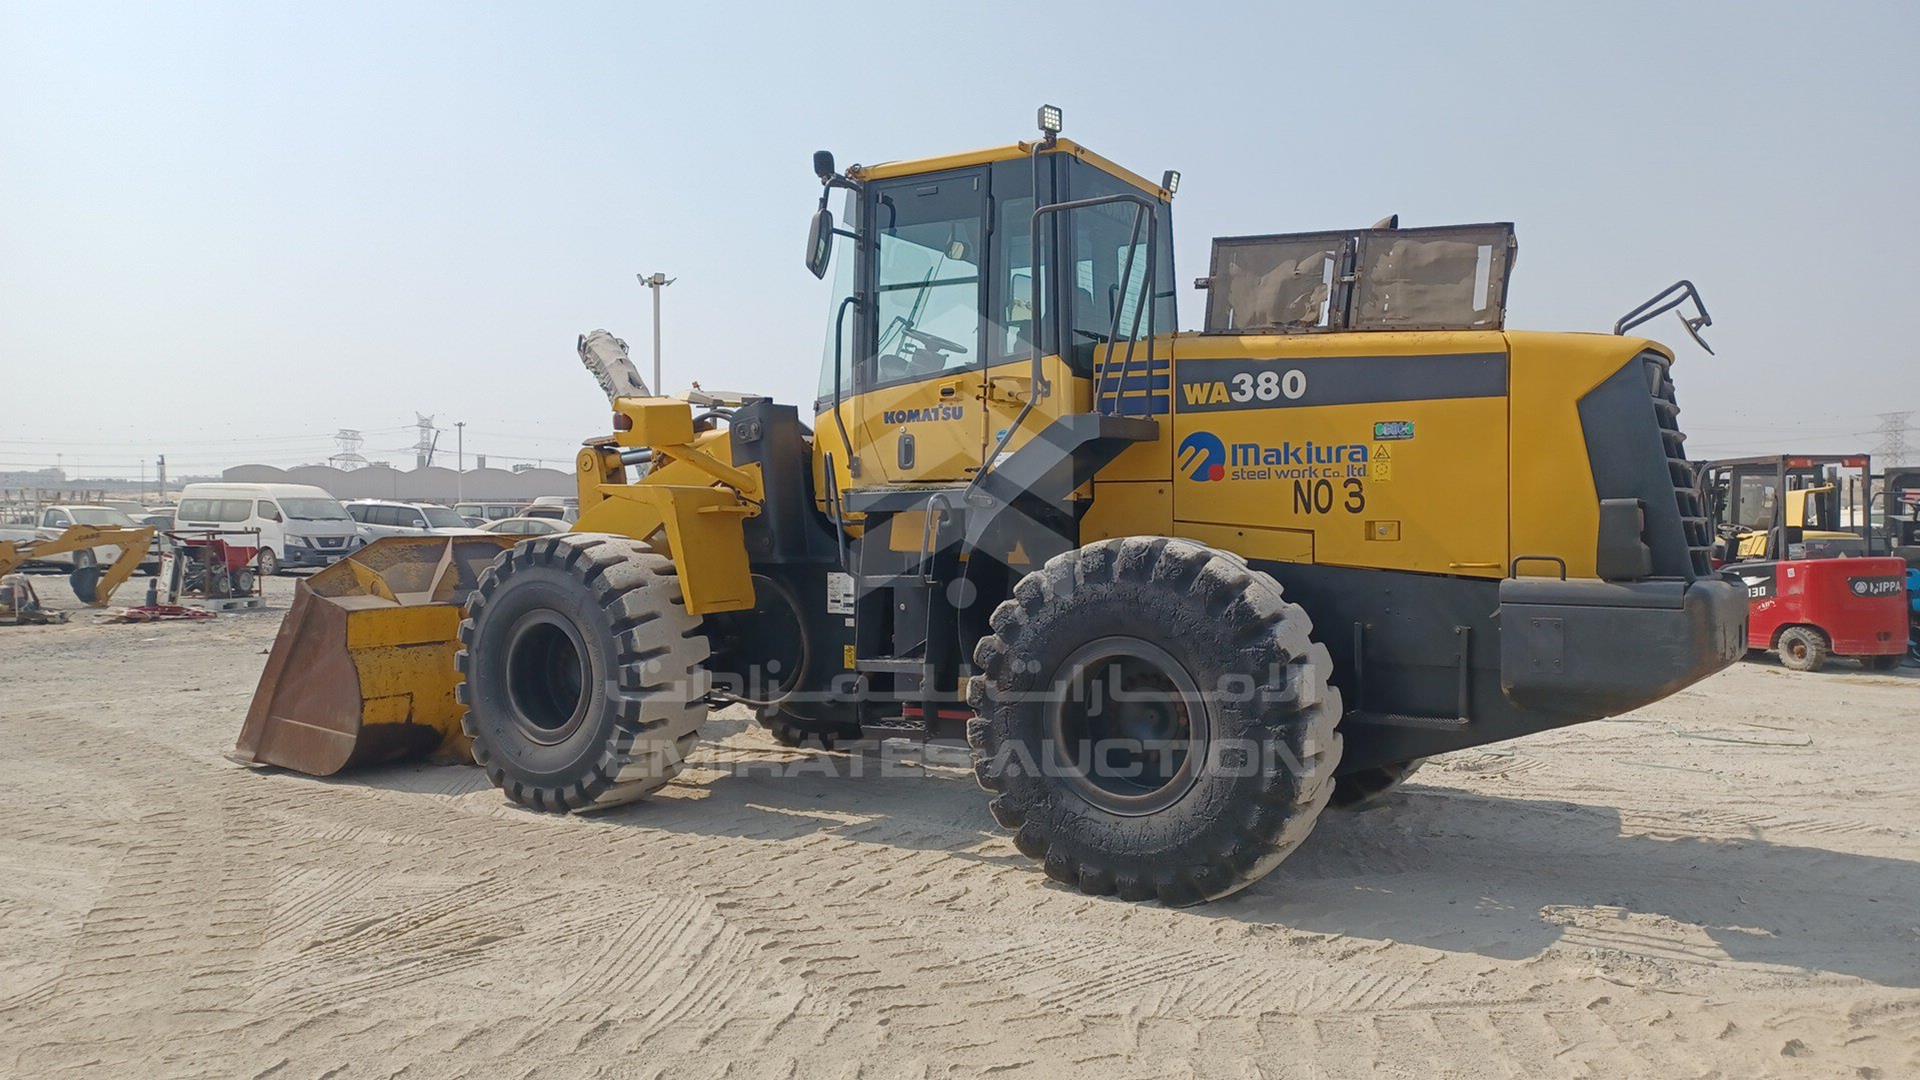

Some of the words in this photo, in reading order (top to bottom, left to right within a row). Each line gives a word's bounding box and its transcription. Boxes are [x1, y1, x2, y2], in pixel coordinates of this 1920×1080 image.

[883, 405, 964, 424] KOMATSU
[1231, 467, 1271, 481] steel
[1275, 465, 1318, 480] work
[1293, 479, 1333, 514] NO
[1343, 478, 1366, 514] 3
